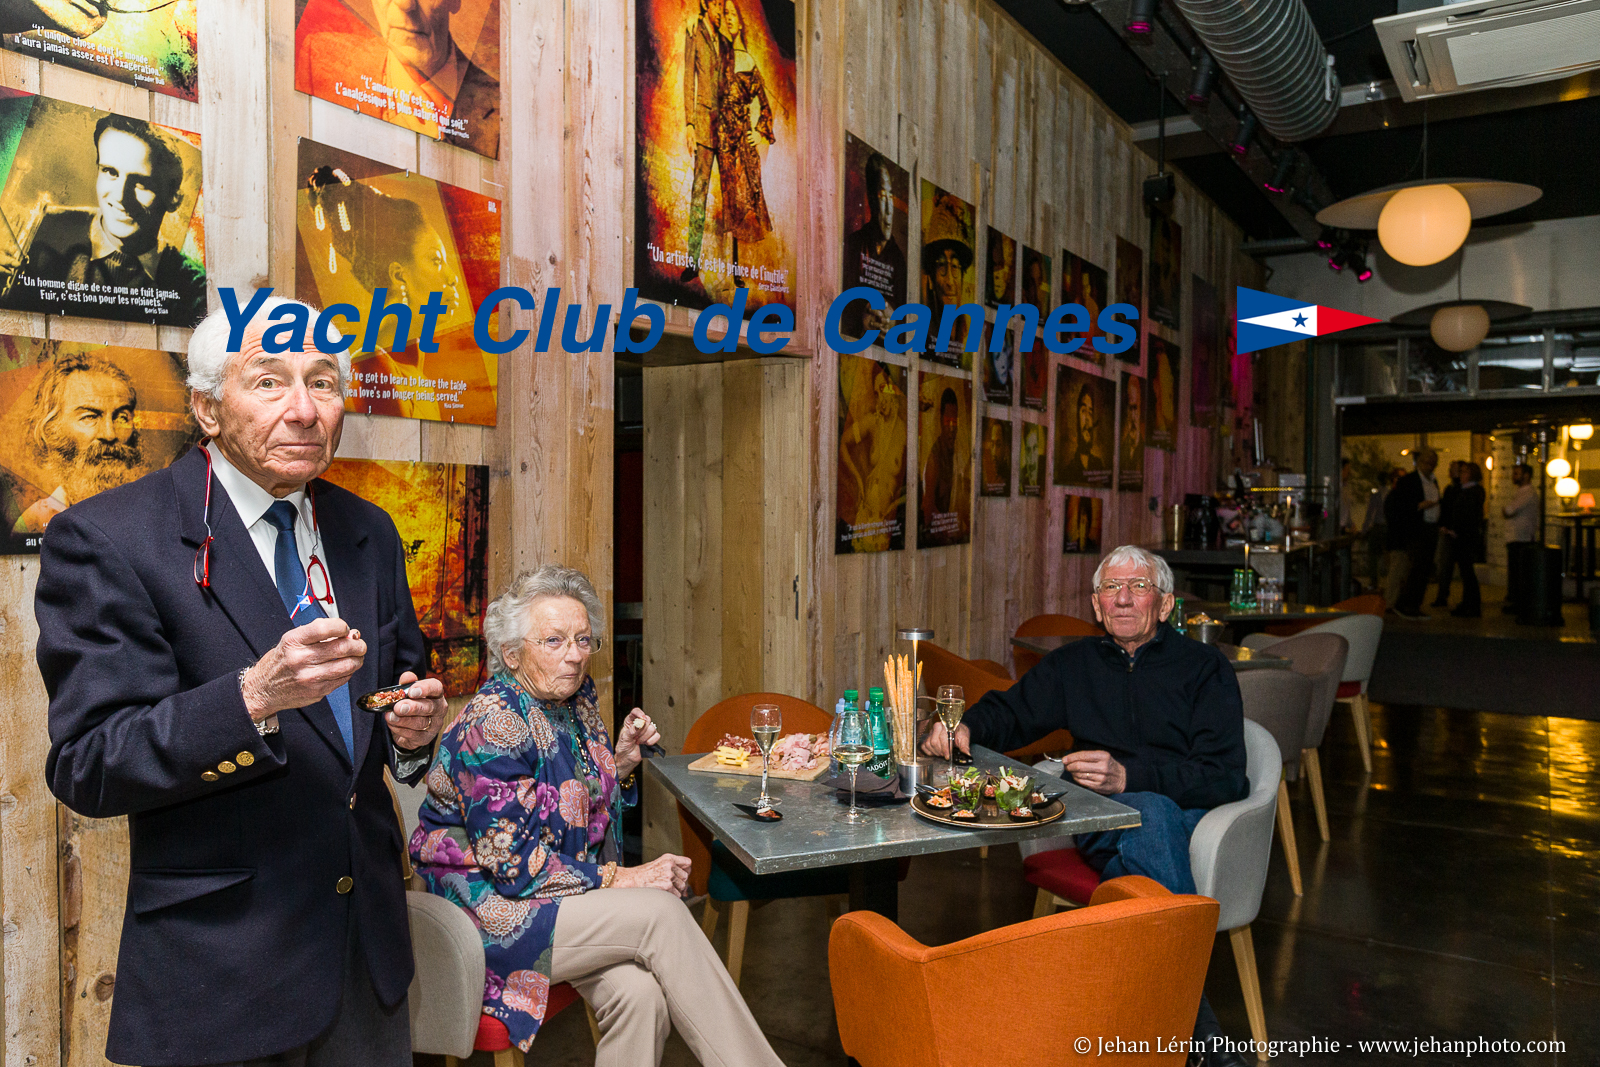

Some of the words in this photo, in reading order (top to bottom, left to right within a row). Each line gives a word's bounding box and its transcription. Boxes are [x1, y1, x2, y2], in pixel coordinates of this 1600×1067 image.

[14, 32, 42, 49] n'aura
[43, 40, 70, 56] jamais
[72, 49, 94, 62] assez
[96, 54, 109, 65] est
[72, 37, 96, 50] chose
[98, 43, 114, 56] dont
[116, 47, 123, 58] le
[125, 52, 148, 64] monde
[335, 82, 387, 107] L'analgésique
[388, 98, 395, 110] le
[397, 102, 412, 115] plus
[413, 108, 438, 123] naturel
[439, 116, 450, 126] qui
[647, 242, 664, 262] "Un
[666, 250, 696, 271] artiste,
[698, 253, 716, 273] c'est
[719, 258, 725, 273] le
[727, 262, 748, 277] prince
[751, 266, 759, 279] de
[18, 274, 35, 286] "Un
[37, 277, 65, 288] homme
[68, 280, 89, 291] digne
[90, 283, 100, 292] de
[102, 285, 111, 293] ce
[113, 286, 128, 294] nom
[130, 288, 139, 296] ne
[140, 286, 154, 297] fuit
[156, 289, 180, 299] jamais.
[40, 289, 59, 302] Fuir,
[61, 290, 81, 302] c'est
[83, 293, 97, 303] bon
[99, 295, 116, 304] pour
[118, 295, 129, 305] les
[365, 372, 378, 384] got
[380, 373, 388, 384] to
[390, 373, 408, 386] learn
[409, 375, 417, 387] to
[418, 376, 436, 388] leave
[438, 378, 449, 389] the
[450, 380, 467, 390] table
[359, 386, 380, 398] love's
[382, 390, 390, 398] no
[392, 388, 414, 401] longer
[416, 391, 435, 402] being
[26, 538, 36, 546] au
